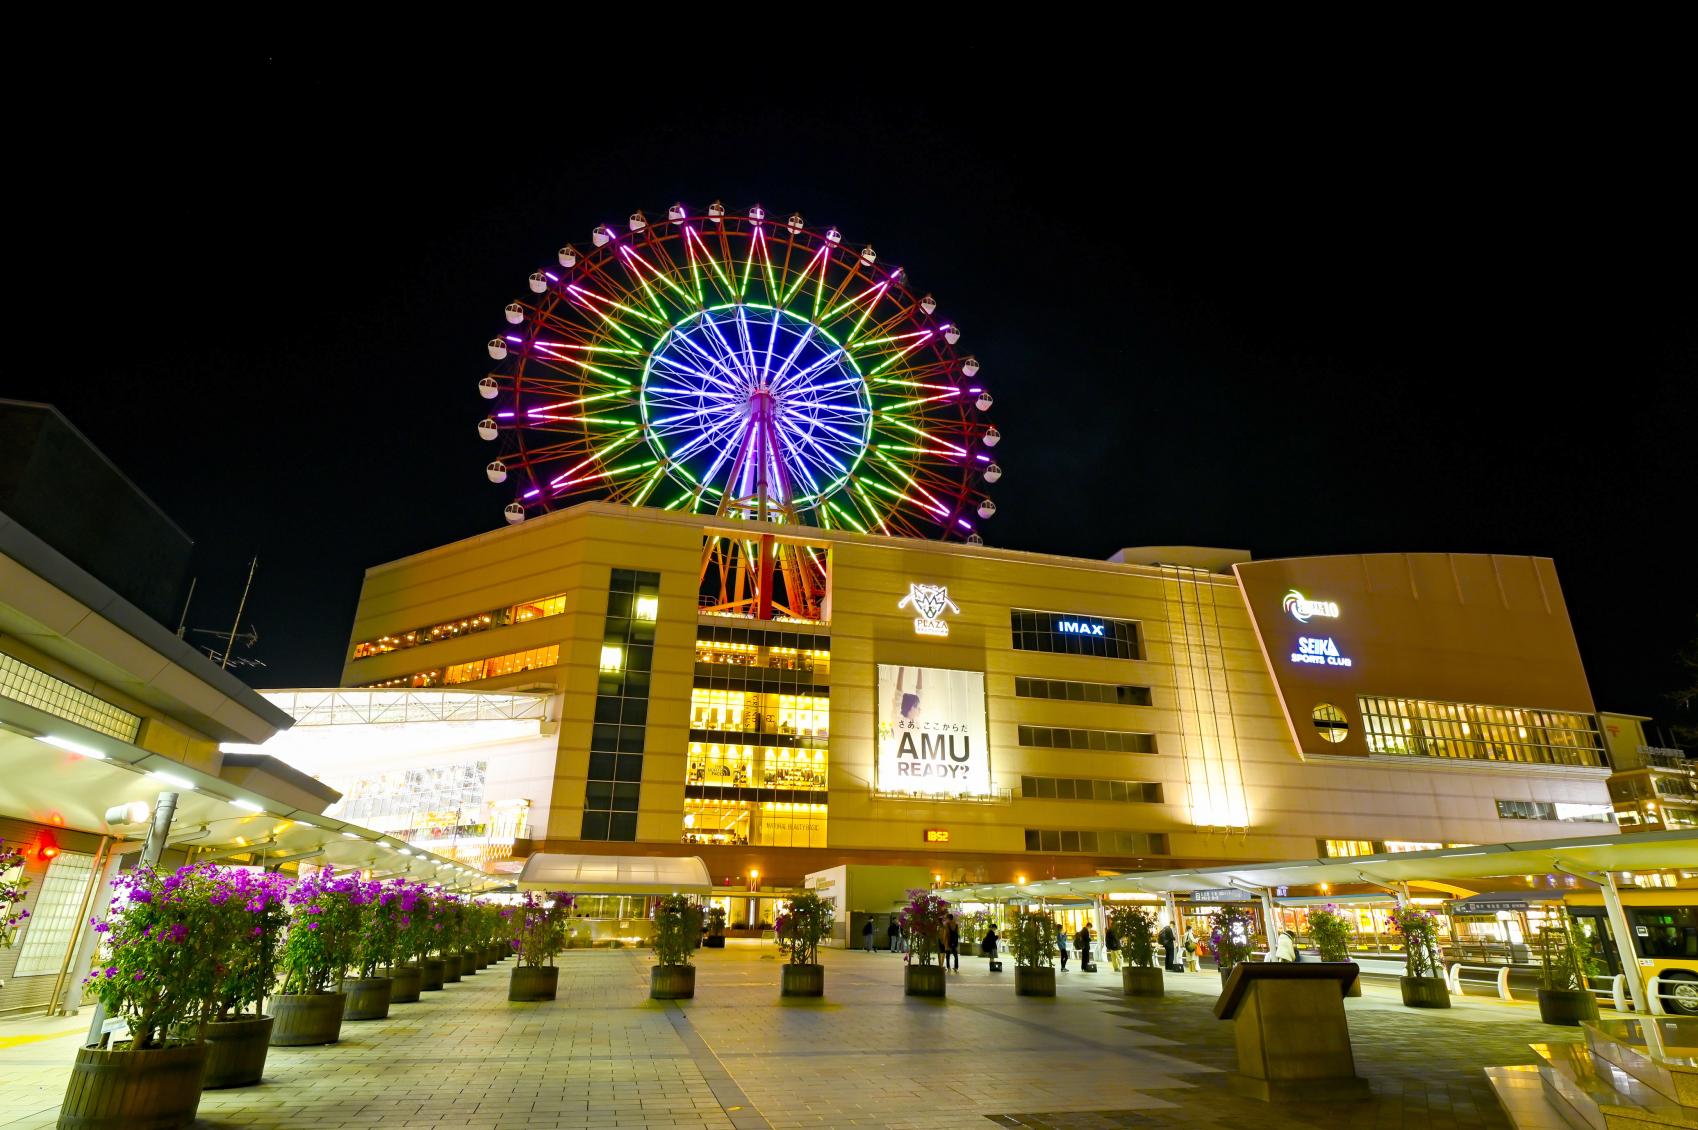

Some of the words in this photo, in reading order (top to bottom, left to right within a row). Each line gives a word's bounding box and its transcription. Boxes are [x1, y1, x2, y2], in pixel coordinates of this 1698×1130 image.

[917, 619, 948, 629] PLAZA
[1058, 621, 1104, 636] IMAX
[1298, 636, 1340, 657] SEIKA
[1291, 653, 1326, 665] SPORTS
[1327, 656, 1352, 667] CLUB
[896, 731, 970, 763] AMU
[897, 761, 970, 780] READY?
